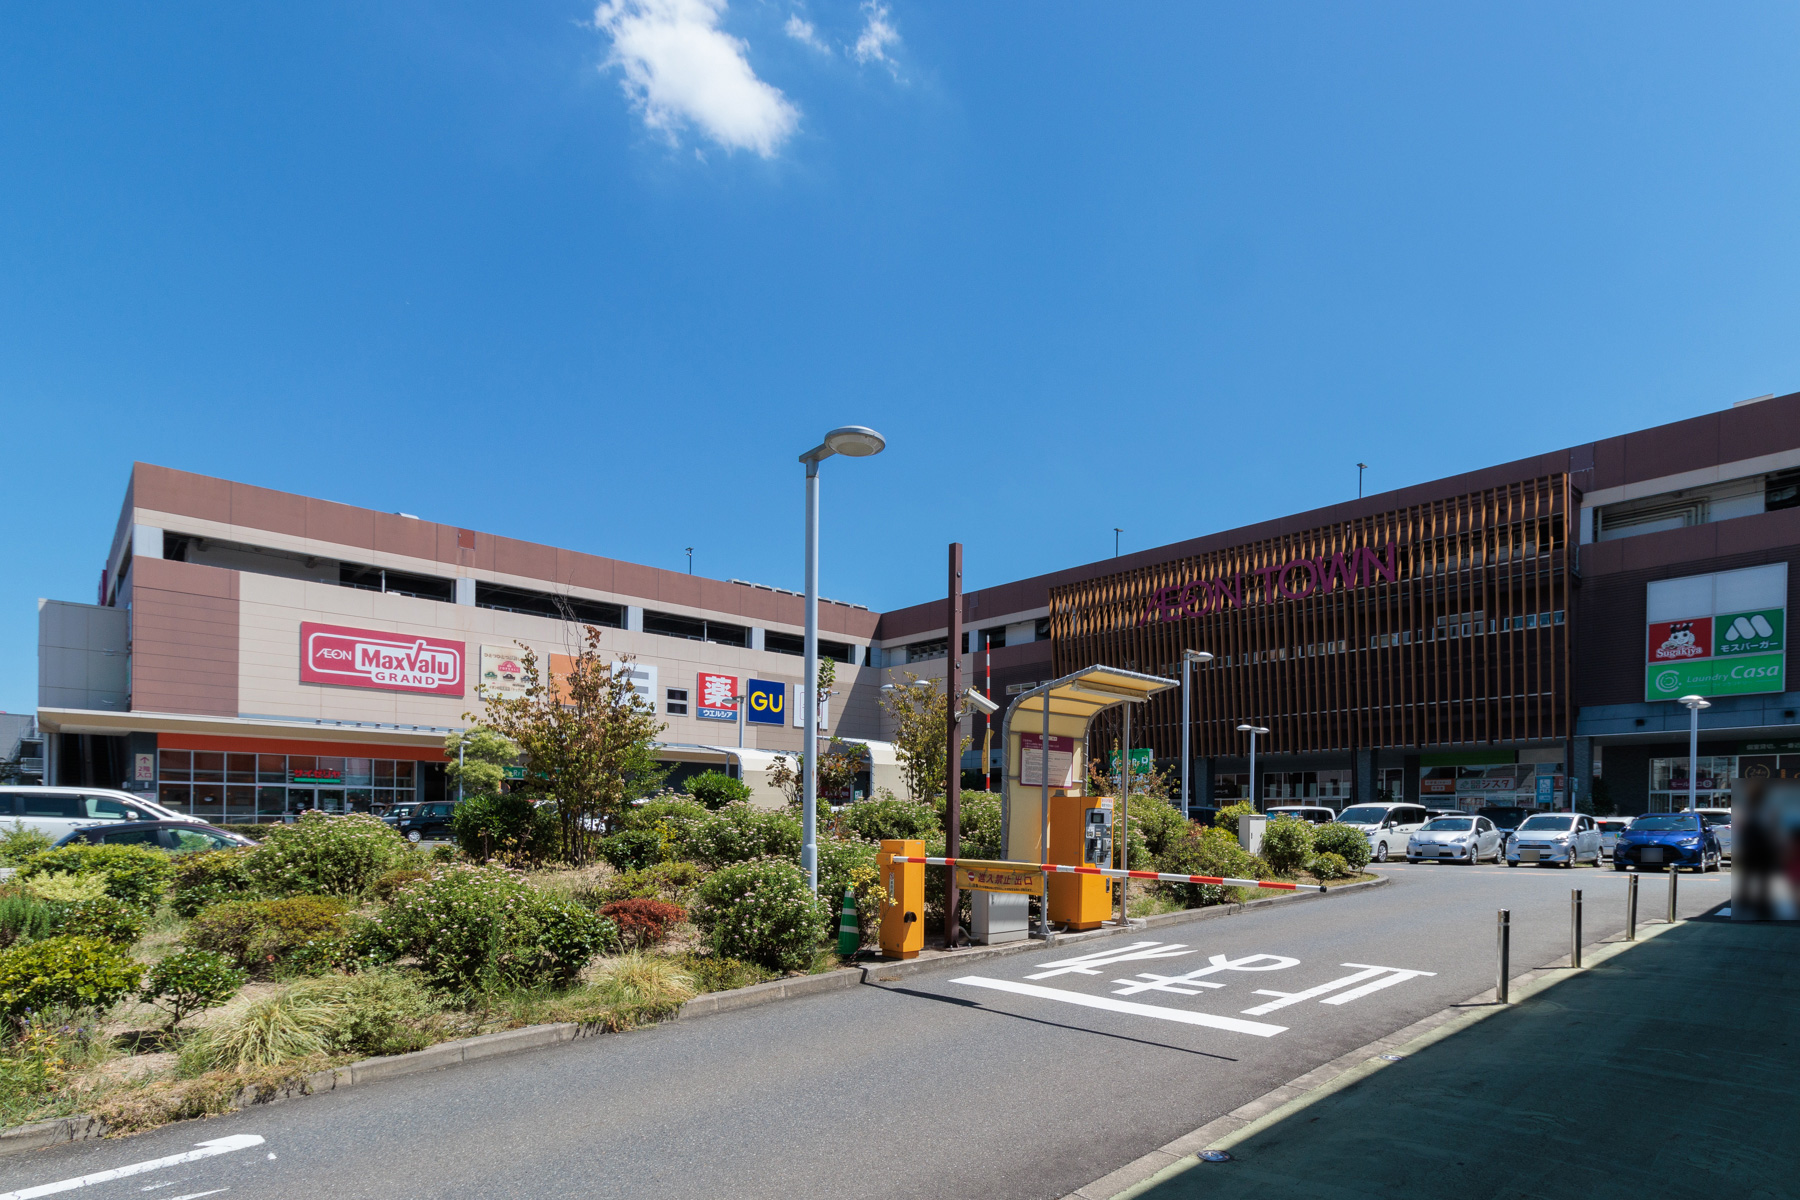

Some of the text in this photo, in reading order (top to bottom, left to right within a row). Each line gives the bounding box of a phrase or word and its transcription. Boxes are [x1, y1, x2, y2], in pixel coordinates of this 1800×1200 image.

[1255, 542, 1396, 604] TOWN
[1656, 645, 1703, 659] Sugakiya
[1720, 640, 1779, 653] モスバーガー
[361, 642, 449, 676] MaxValu
[375, 671, 436, 686] GRAND
[1686, 665, 1780, 683] Laundry Casa
[703, 675, 732, 708] 薬
[750, 690, 784, 713] GU
[702, 709, 732, 719] ウエルシア
[293, 769, 341, 779] サイゼリヤ
[978, 872, 1033, 886] 進入禁止 出口
